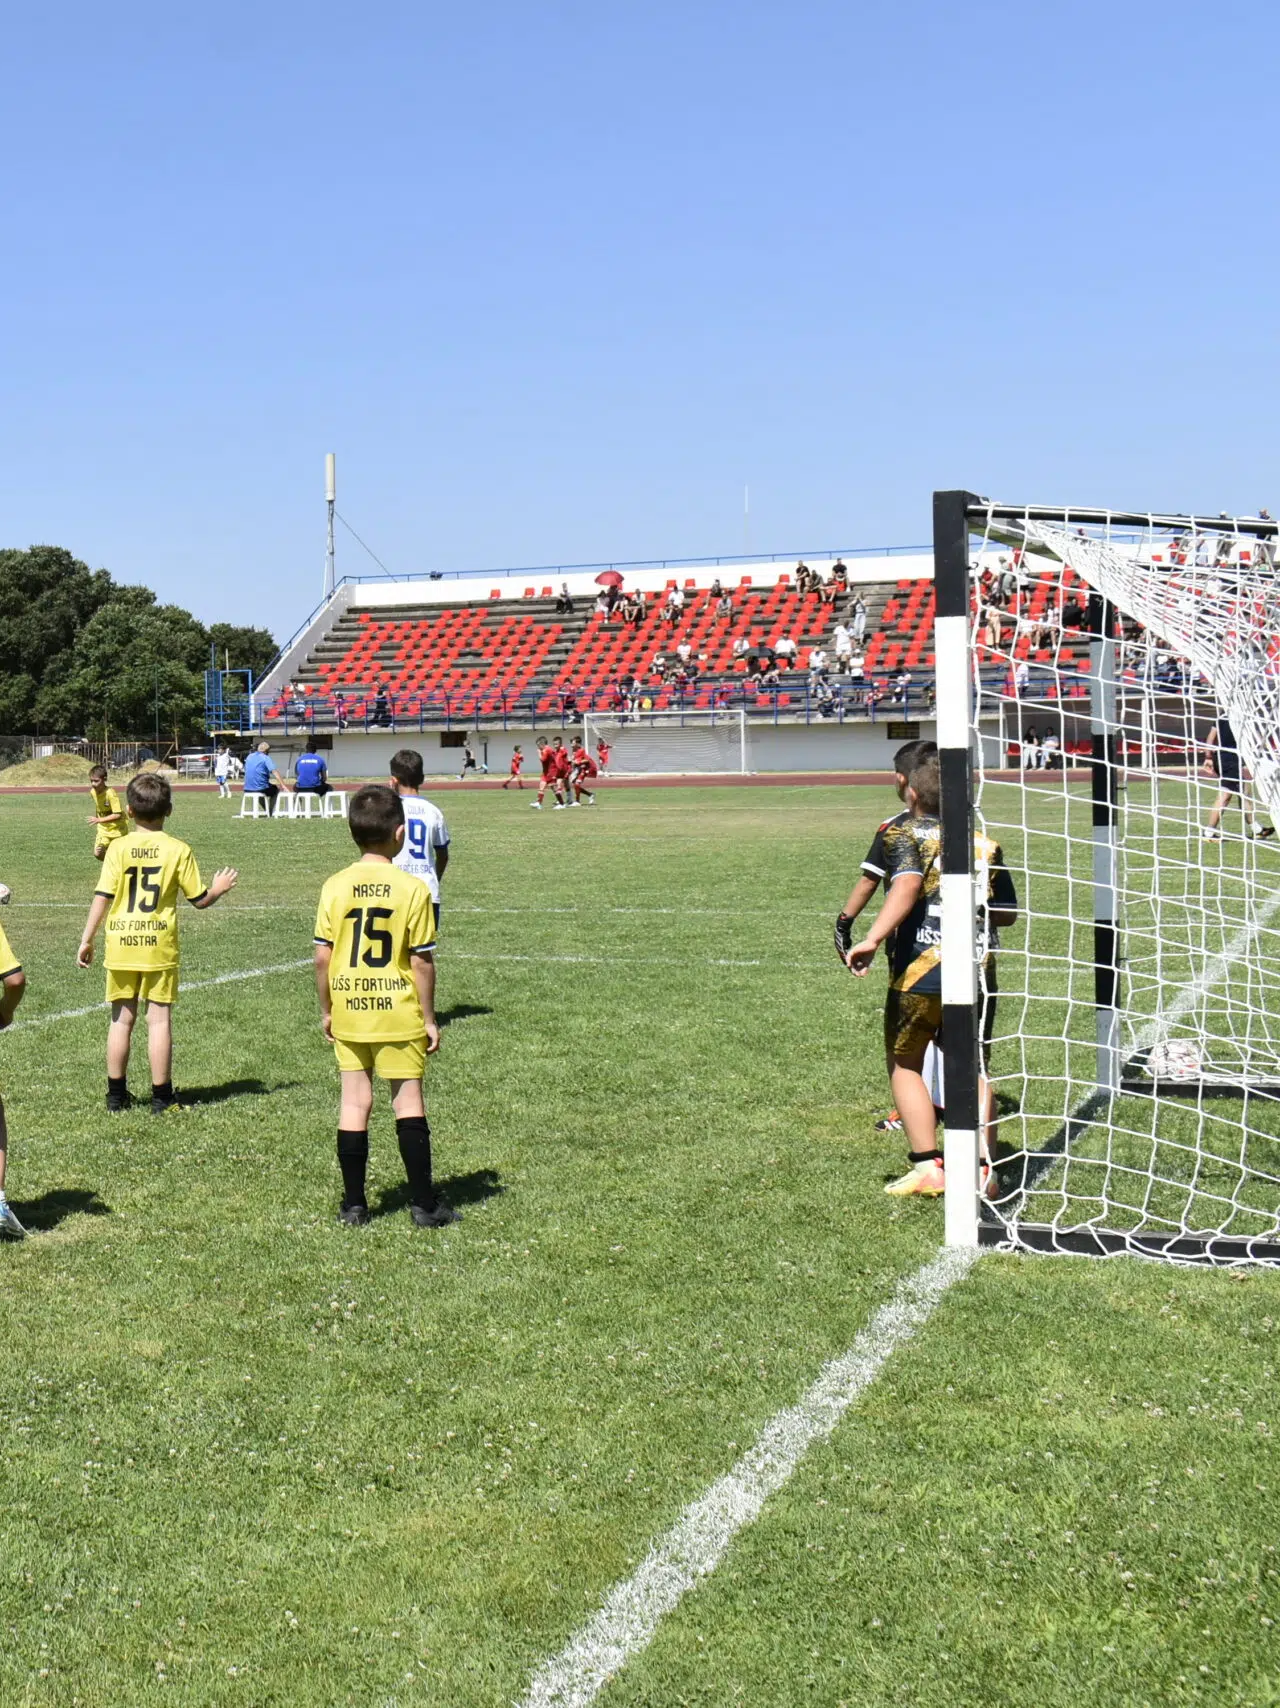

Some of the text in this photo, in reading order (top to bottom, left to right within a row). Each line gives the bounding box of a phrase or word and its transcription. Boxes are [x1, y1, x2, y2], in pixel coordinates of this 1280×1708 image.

[408, 818, 427, 859] 9
[124, 865, 163, 914] 15
[353, 883, 391, 898] NASER
[129, 920, 168, 931] FORTUNA
[120, 935, 158, 946] MOSTAR
[343, 906, 395, 969] 15
[332, 974, 408, 992] UŠS FORTUNA
[346, 997, 393, 1010] MOSTAR
